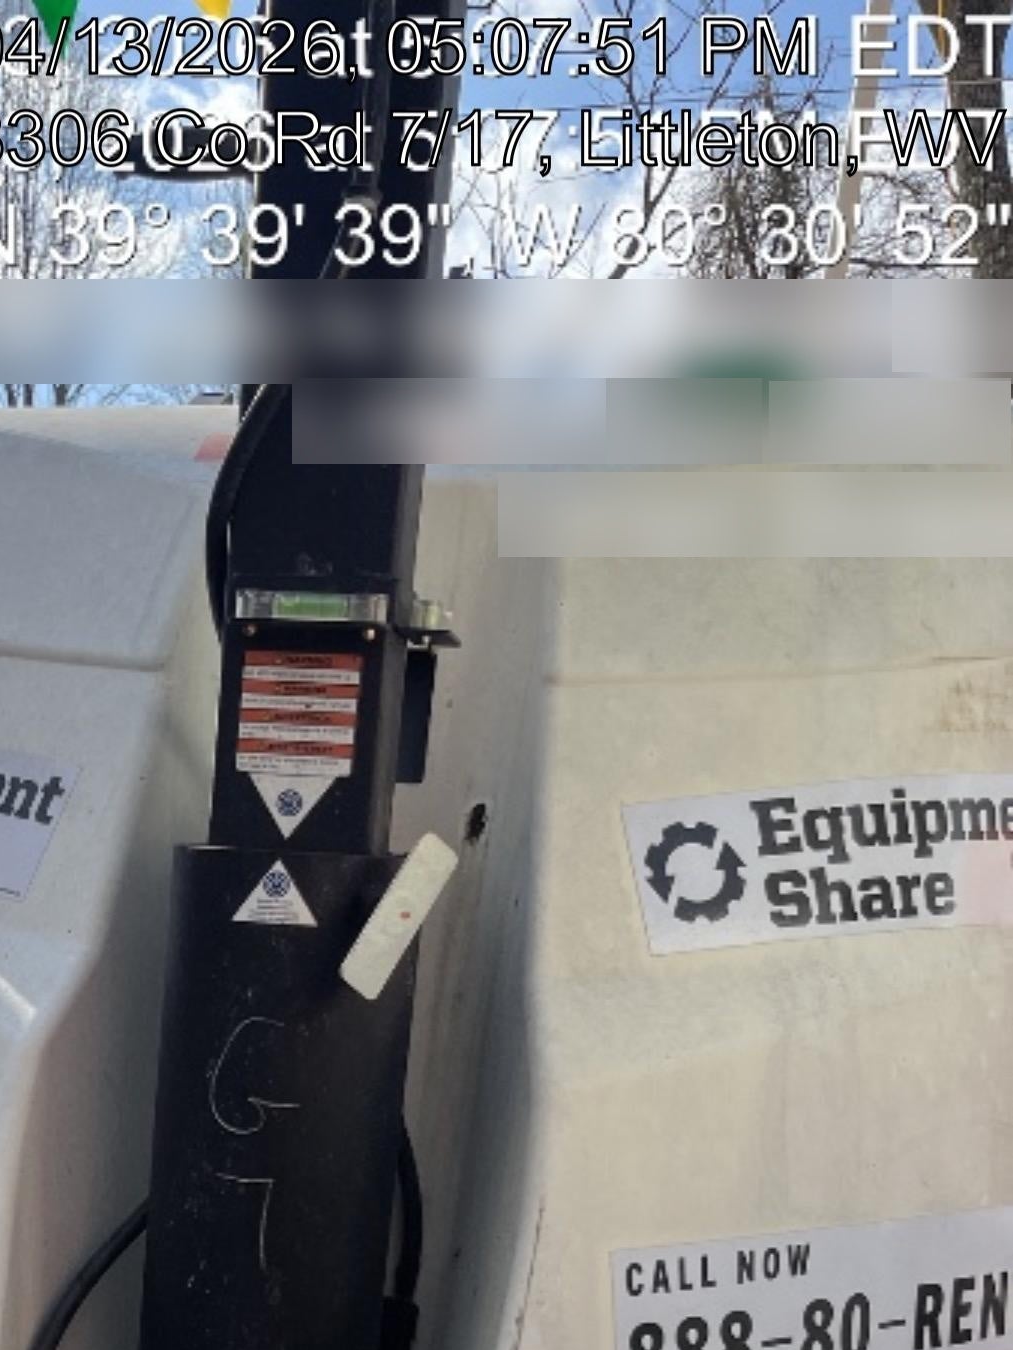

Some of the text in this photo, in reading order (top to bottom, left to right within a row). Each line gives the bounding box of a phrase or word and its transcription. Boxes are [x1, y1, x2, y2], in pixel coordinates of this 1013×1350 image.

[764, 866, 957, 928] Share
[625, 1243, 811, 1297] CALL NOW
